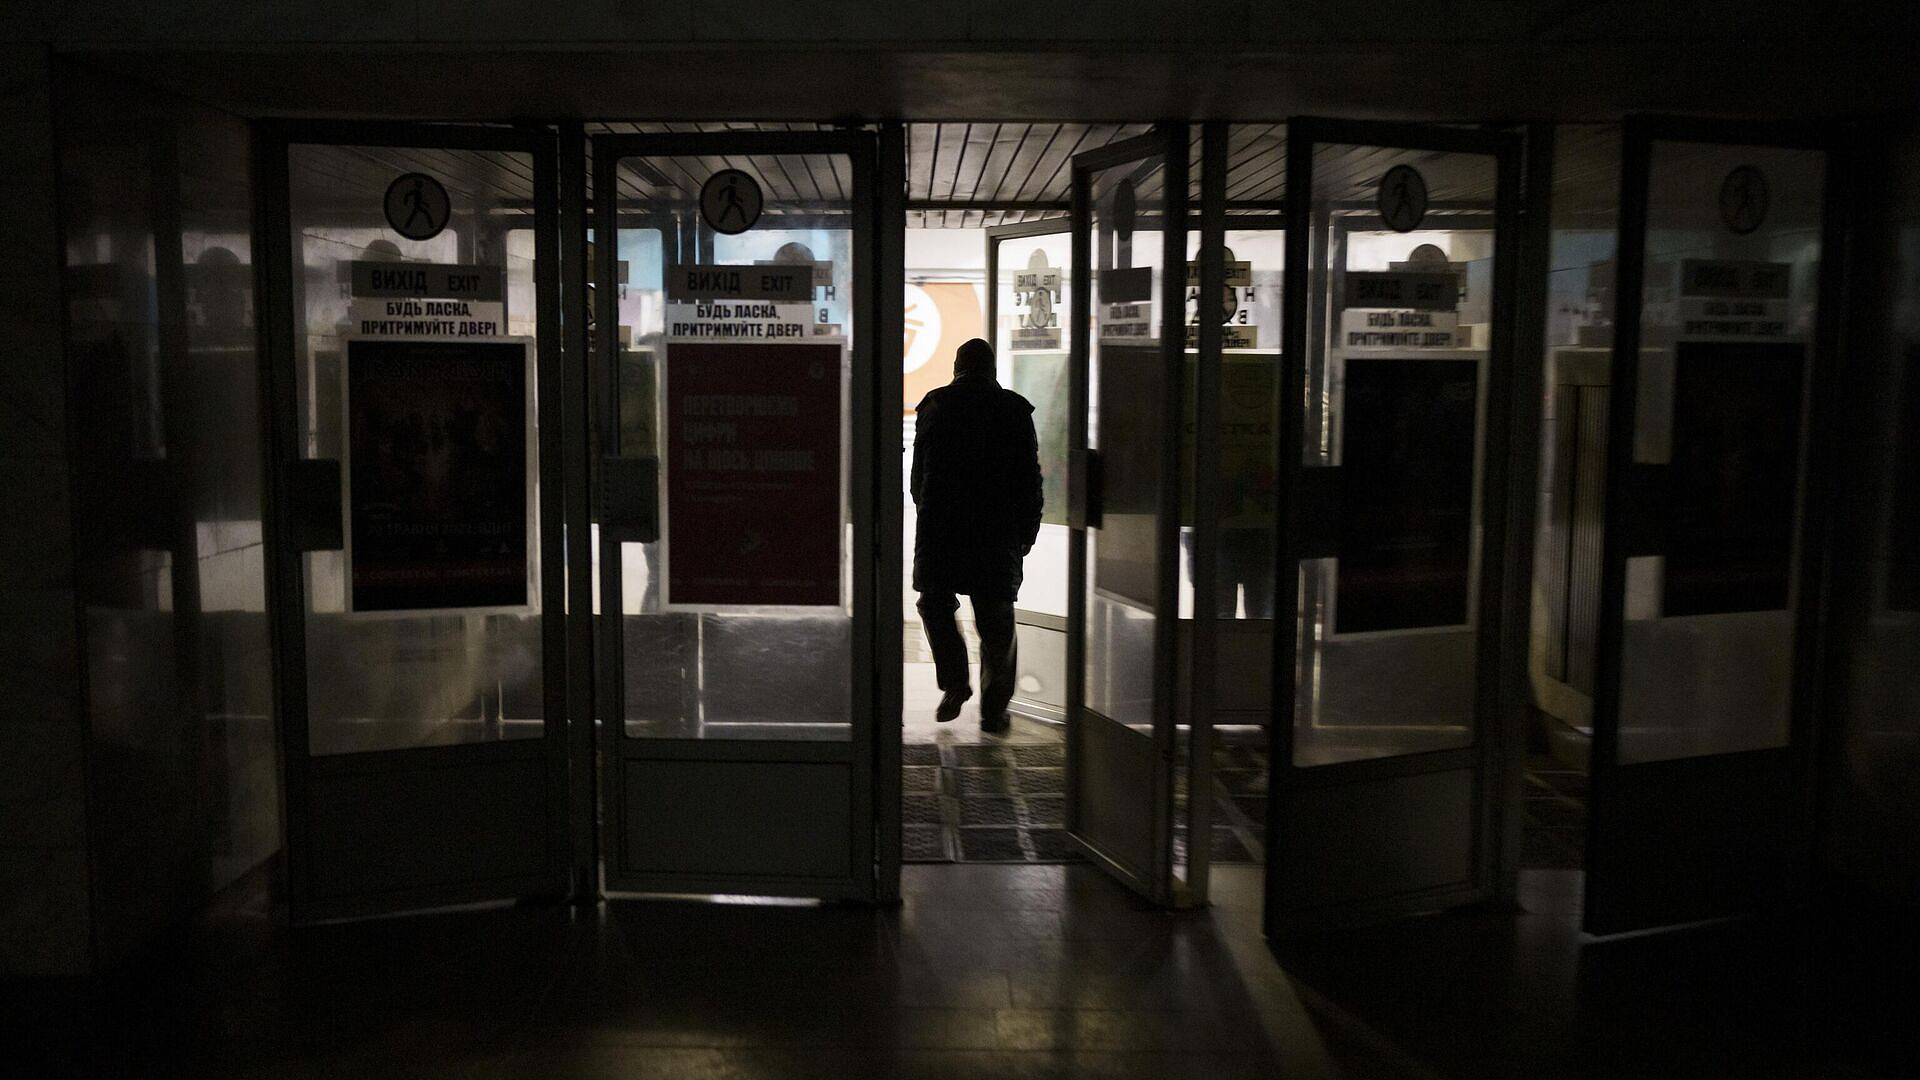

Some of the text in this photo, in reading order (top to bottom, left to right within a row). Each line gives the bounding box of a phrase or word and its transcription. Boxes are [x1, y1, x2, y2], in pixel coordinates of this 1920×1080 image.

[372, 269, 480, 294] ВИХІД EXIT
[687, 272, 793, 294] ВИХІД EXIT
[386, 302, 472, 317] БУДЬ ЛАСКА,
[697, 304, 781, 319] БУДЬ ЛАСКА,
[362, 319, 496, 337] ПРИТРИМУЙТЕ ДВЕРІ
[673, 321, 803, 339] ПРИТРИМУЙТЕ ДВЕРІ
